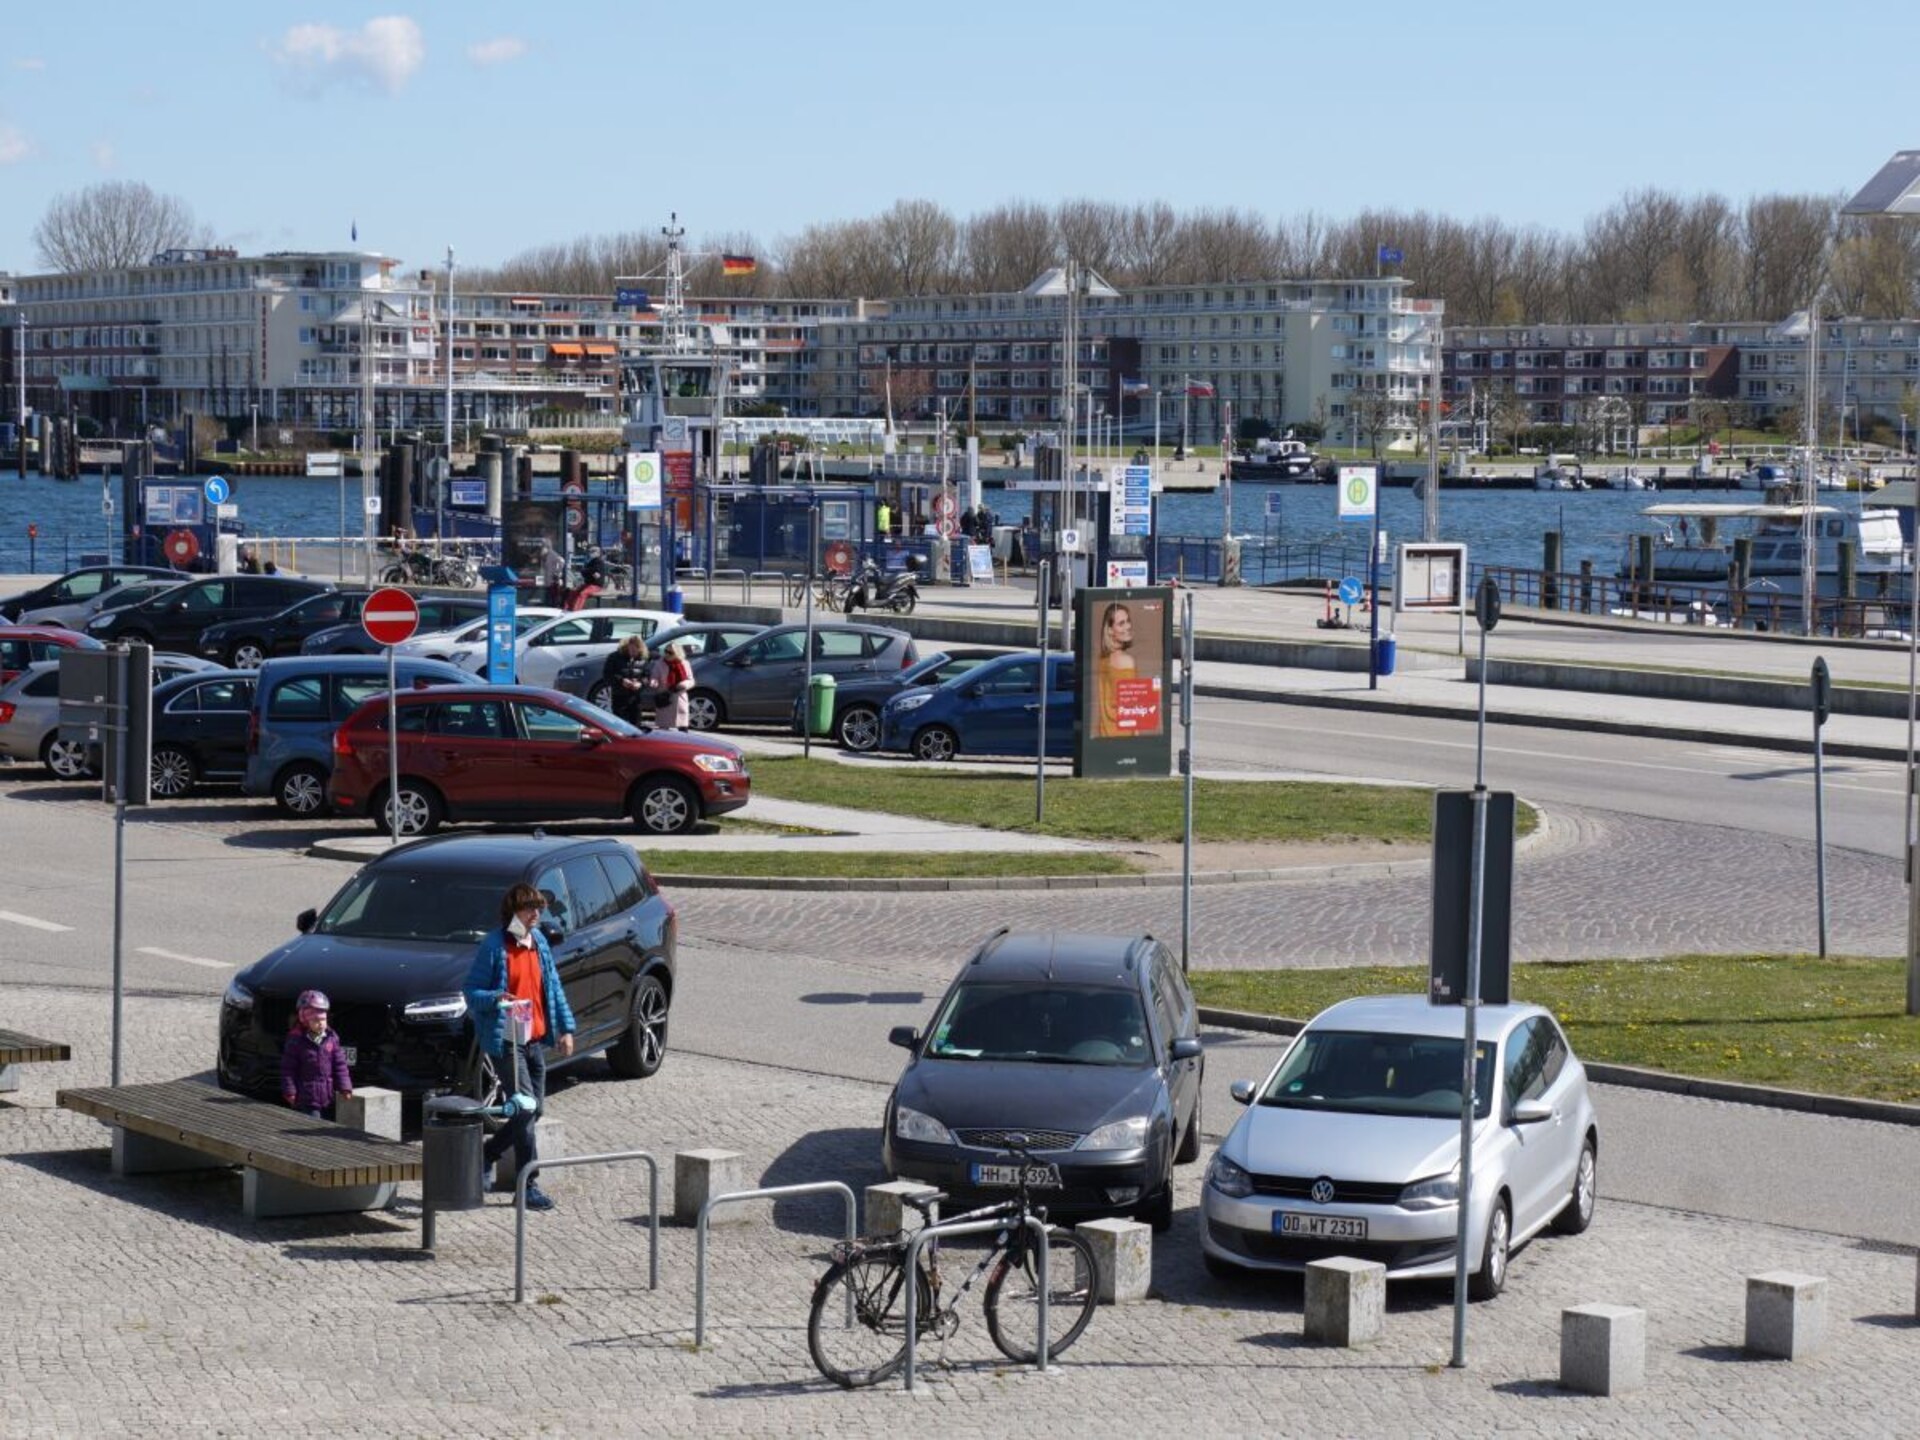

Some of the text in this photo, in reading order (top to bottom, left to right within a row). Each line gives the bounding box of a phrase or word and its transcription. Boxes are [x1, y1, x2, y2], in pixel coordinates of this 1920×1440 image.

[498, 597, 508, 612] P
[1118, 705, 1148, 718] Parship
[981, 1167, 1000, 1182] HH
[1282, 1215, 1363, 1237] OD WT 2311
